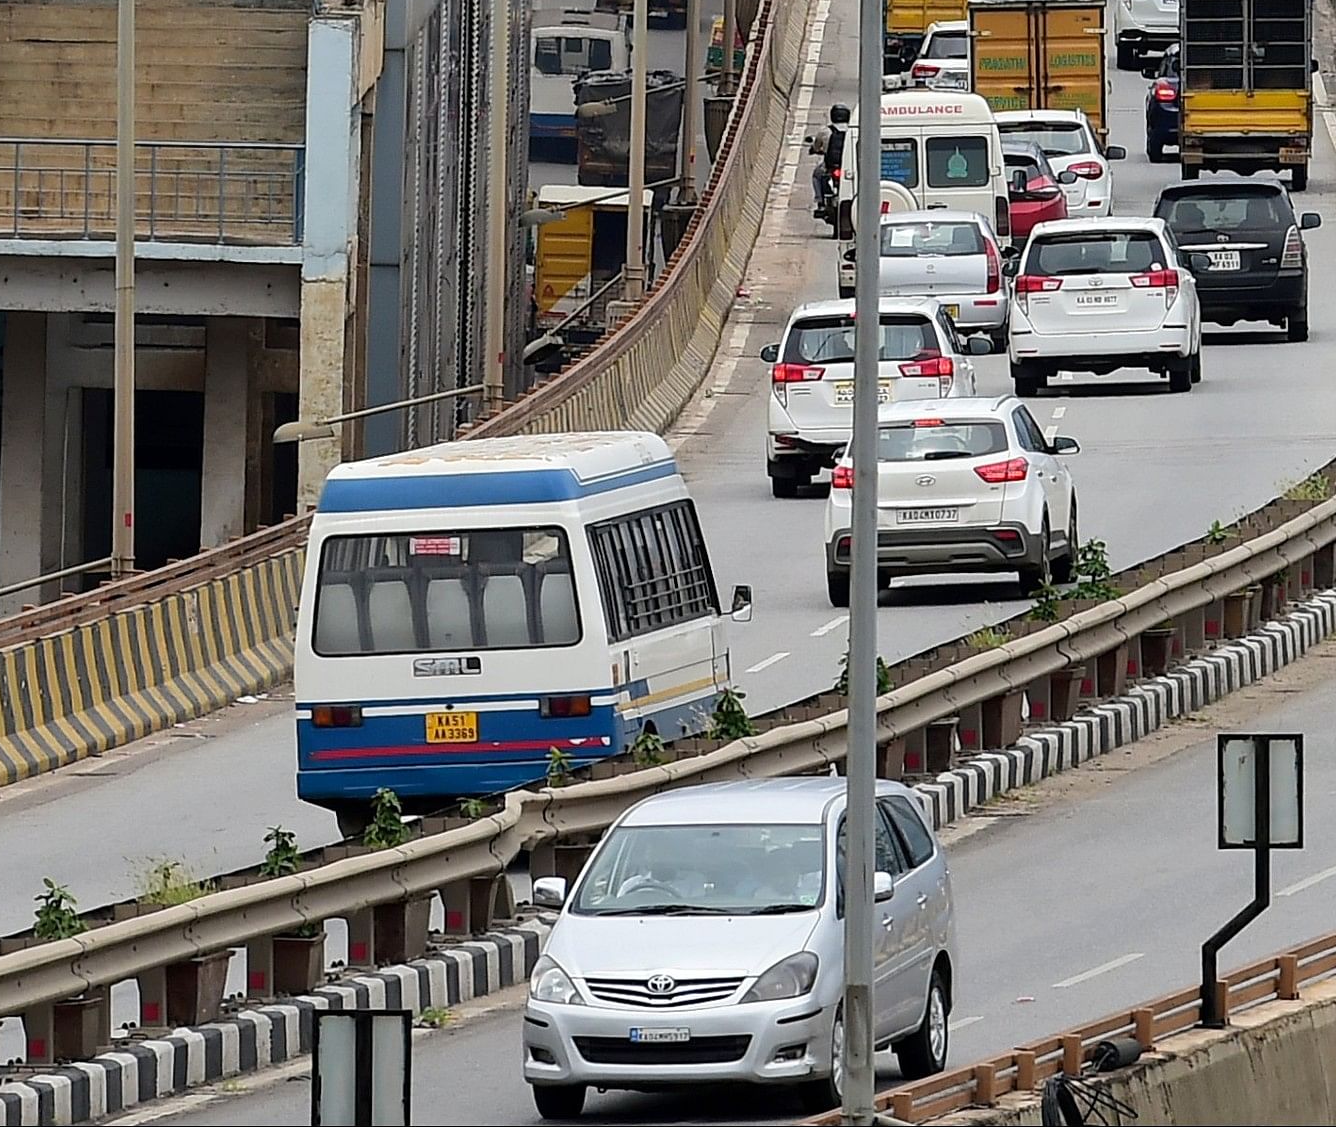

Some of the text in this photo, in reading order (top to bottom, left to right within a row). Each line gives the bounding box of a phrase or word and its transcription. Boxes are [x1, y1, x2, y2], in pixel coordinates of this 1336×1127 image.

[880, 105, 963, 115] AMBULANCE
[437, 715, 465, 727] KA51
[434, 728, 475, 740] AA3369
